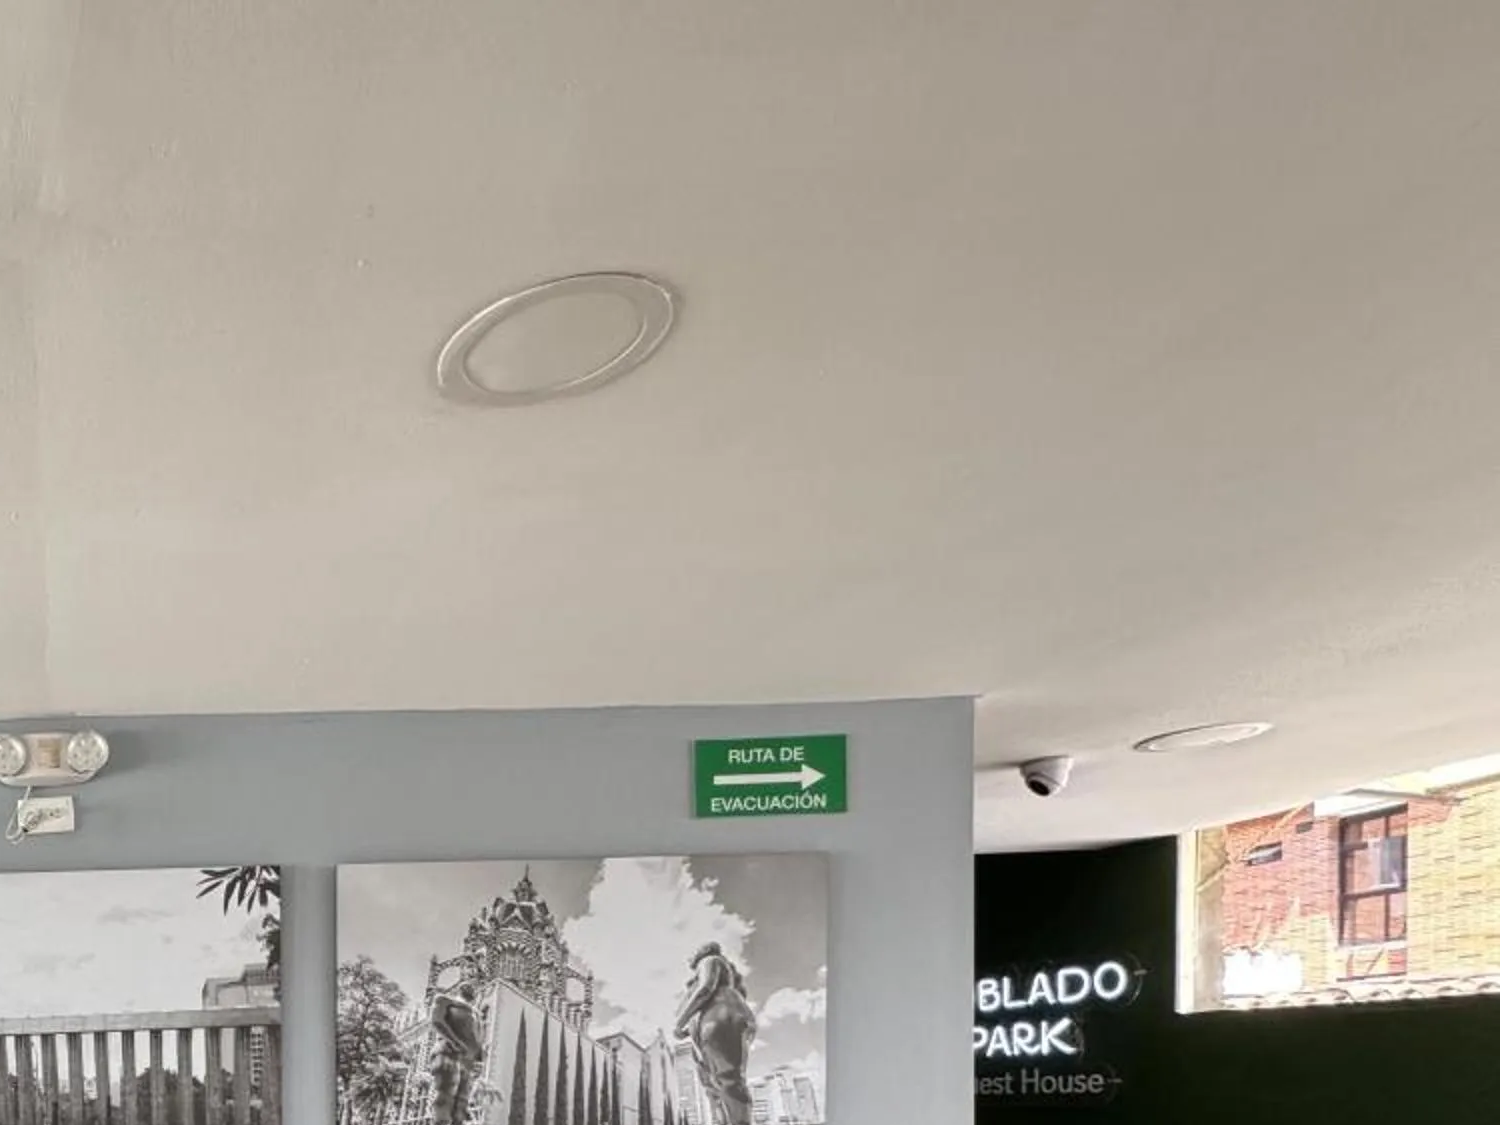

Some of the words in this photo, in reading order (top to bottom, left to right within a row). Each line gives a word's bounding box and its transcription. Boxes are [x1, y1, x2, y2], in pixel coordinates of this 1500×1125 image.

[728, 748, 775, 763] RUTA
[780, 746, 804, 762] DE
[711, 791, 827, 812] EVACUACIÓN
[975, 1072, 1014, 1095] est
[1020, 1068, 1105, 1095] House
